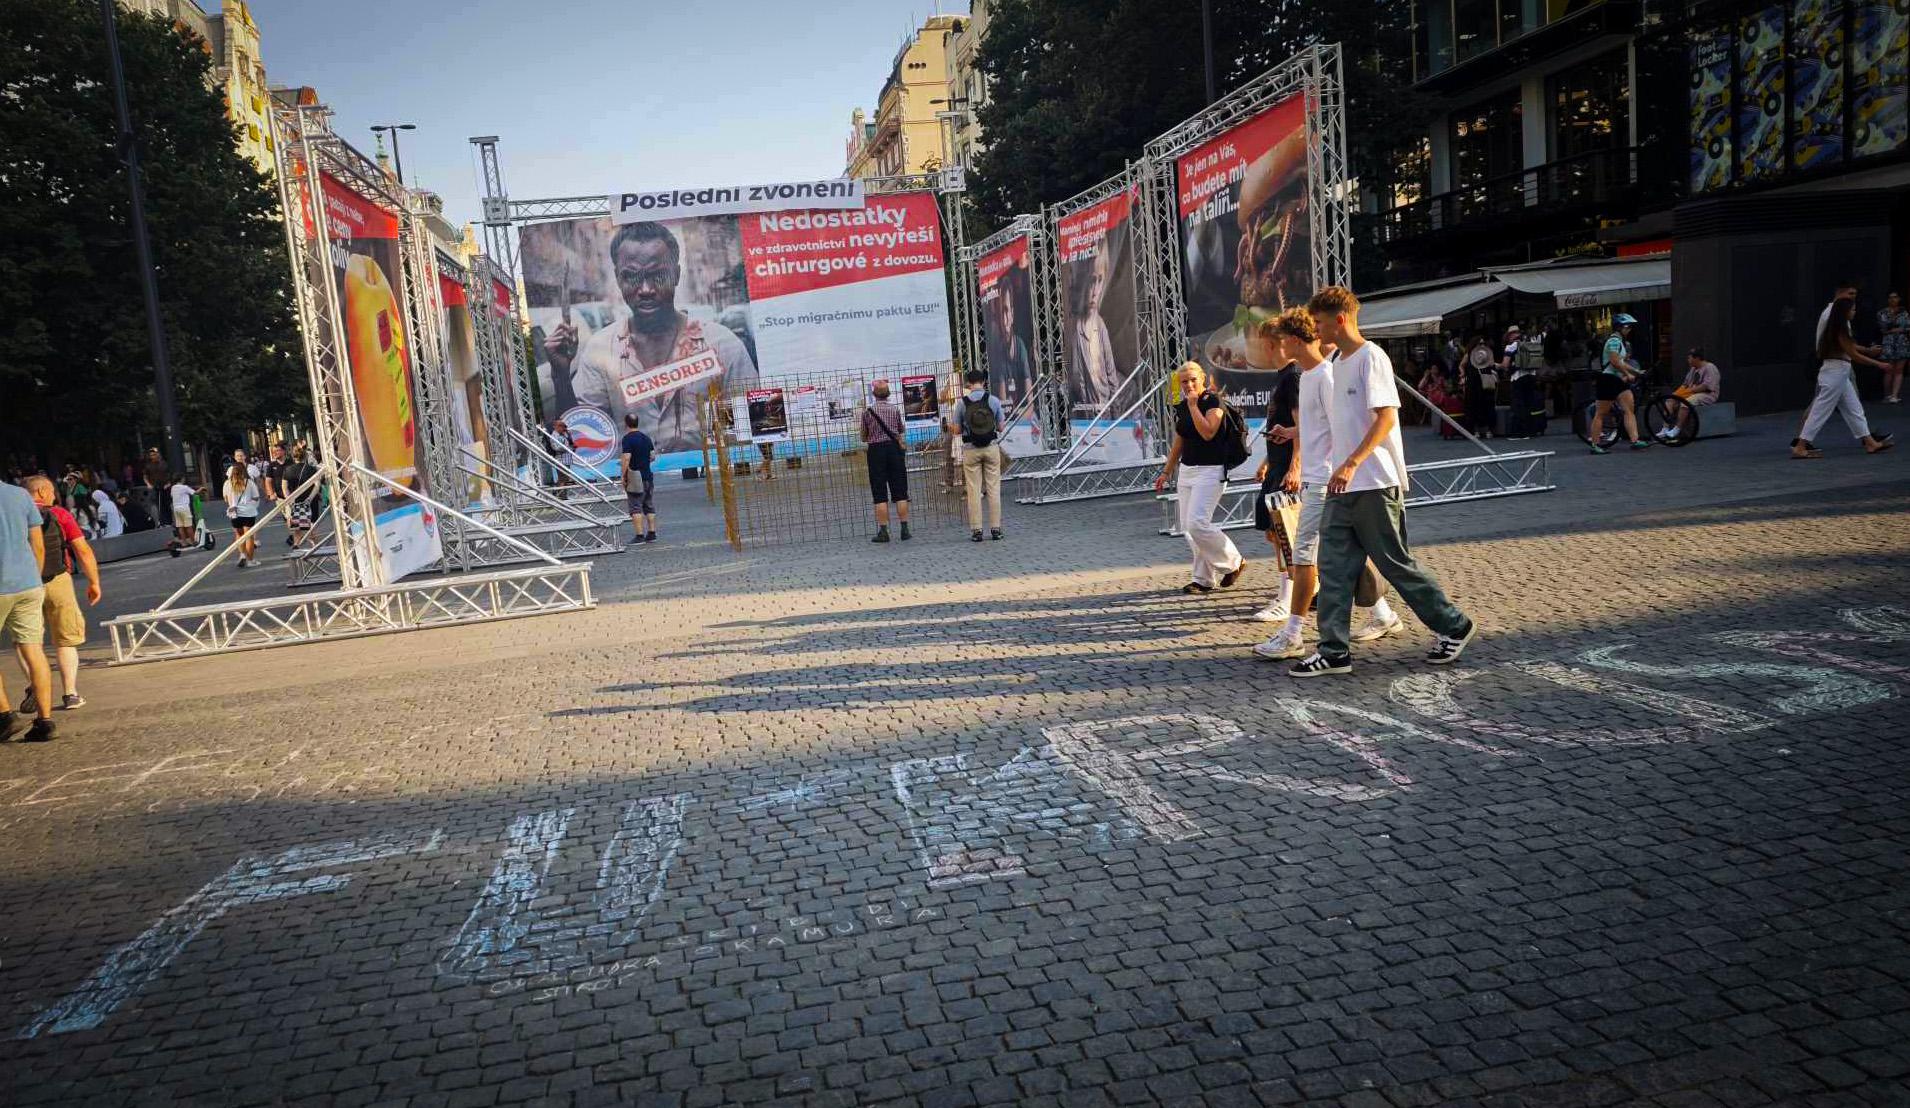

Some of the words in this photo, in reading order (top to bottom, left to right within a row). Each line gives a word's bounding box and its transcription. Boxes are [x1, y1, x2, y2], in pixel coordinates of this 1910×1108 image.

[1194, 157, 1207, 177] jen
[1208, 151, 1218, 167] na
[1182, 191, 1191, 204] co
[1191, 173, 1227, 200] budete
[760, 205, 906, 234] Nedostatky
[1188, 206, 1201, 228] na
[749, 247, 763, 256] ve
[850, 225, 935, 249] nevyřeší
[755, 252, 868, 277] chirurgové
[872, 258, 881, 267] z
[884, 253, 937, 267] dovozu.
[797, 307, 874, 324] migračnímu
[876, 304, 913, 319] paktu
[626, 357, 715, 396] CENSORED
